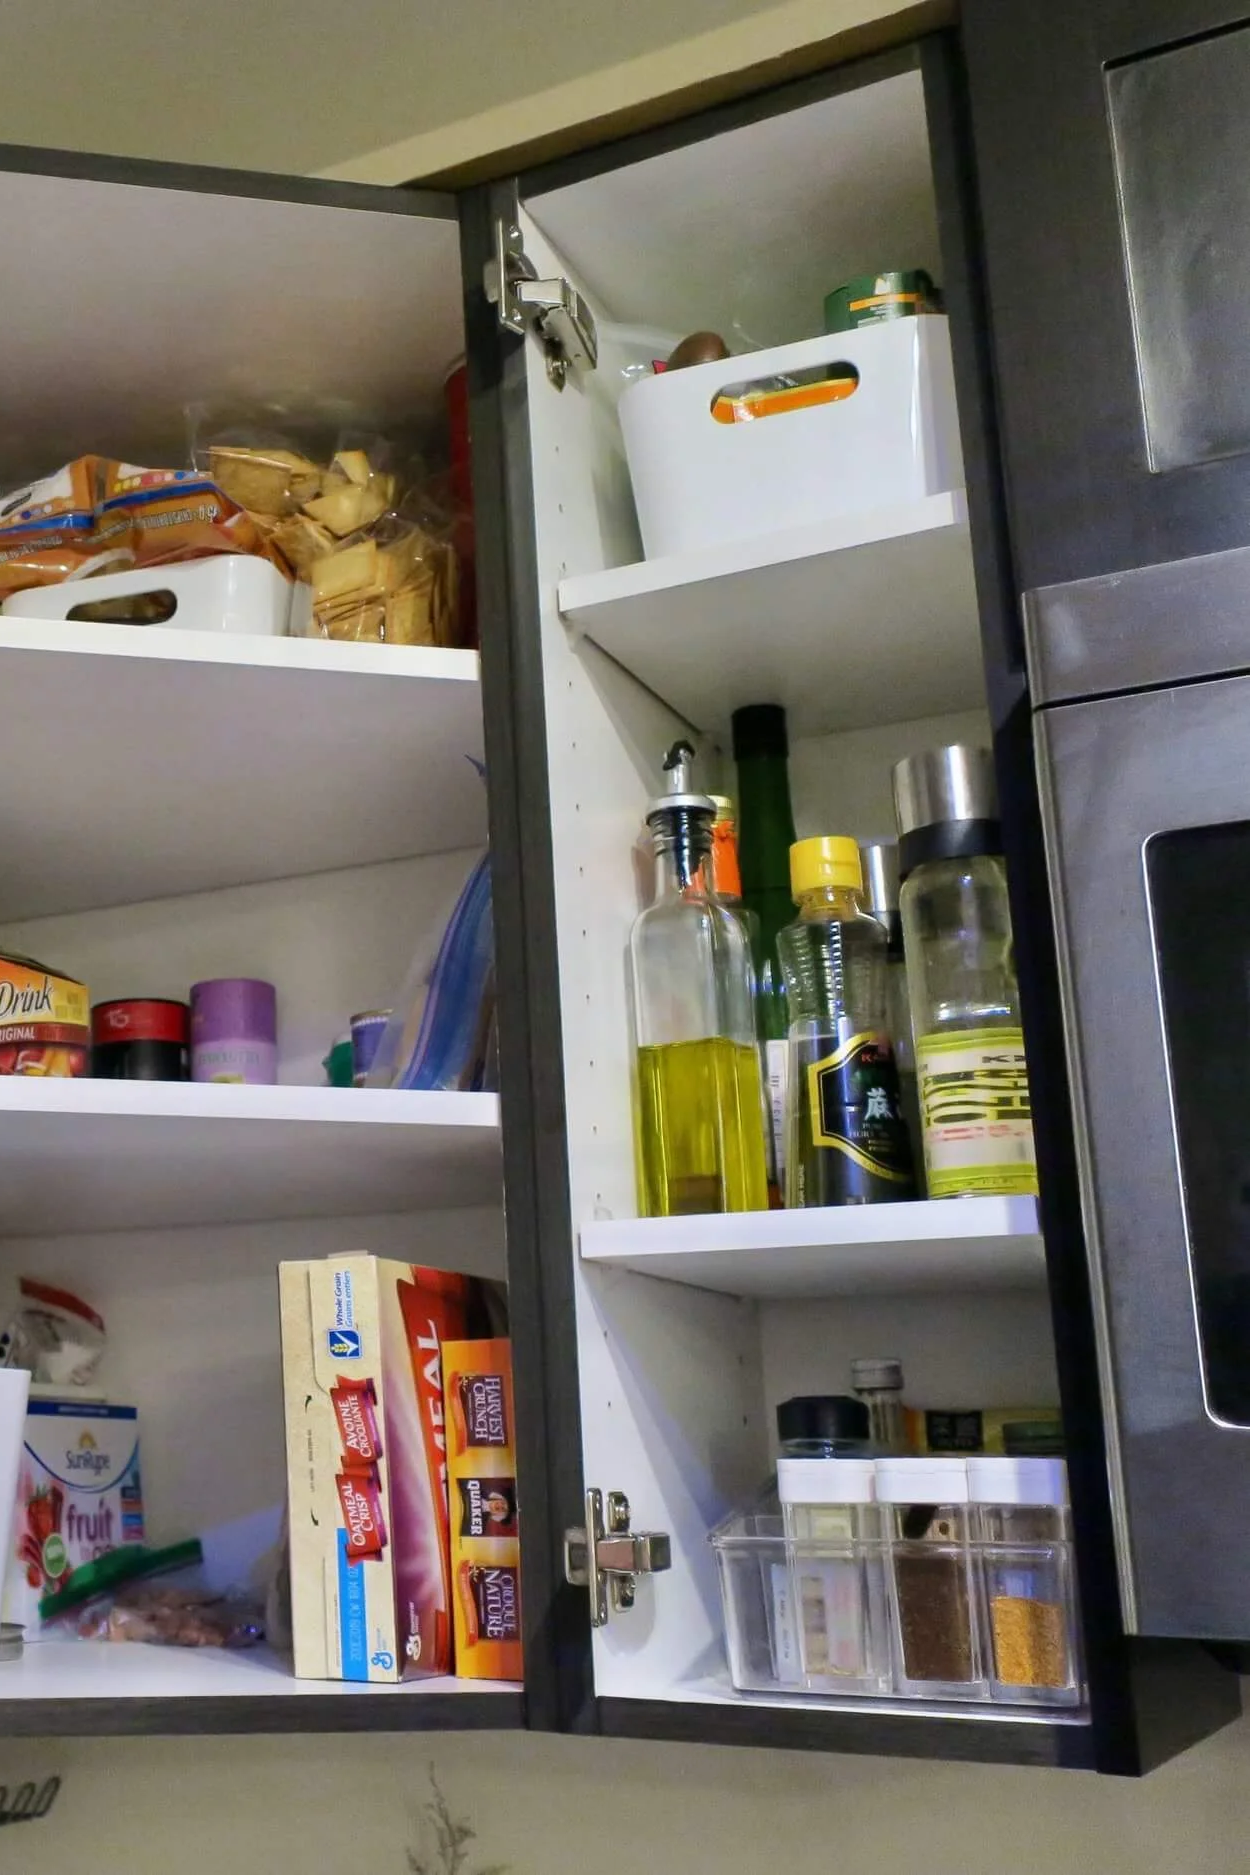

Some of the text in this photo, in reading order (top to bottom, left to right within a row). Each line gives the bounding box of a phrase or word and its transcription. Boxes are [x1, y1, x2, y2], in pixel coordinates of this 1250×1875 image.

[334, 1272, 343, 1327] Whole Grain
[339, 1399, 360, 1450] AVOINE
[349, 1395, 372, 1458] CROQUANTE
[473, 1382, 488, 1439] CRUNCH
[485, 1377, 505, 1444] HARVEST
[67, 1498, 114, 1542] fruit
[342, 1481, 366, 1546] OATMEAL
[355, 1492, 374, 1532] CRISP
[467, 1480, 483, 1535] QUAKER
[485, 1569, 504, 1638] NATURE
[500, 1575, 516, 1632] CROQUE
